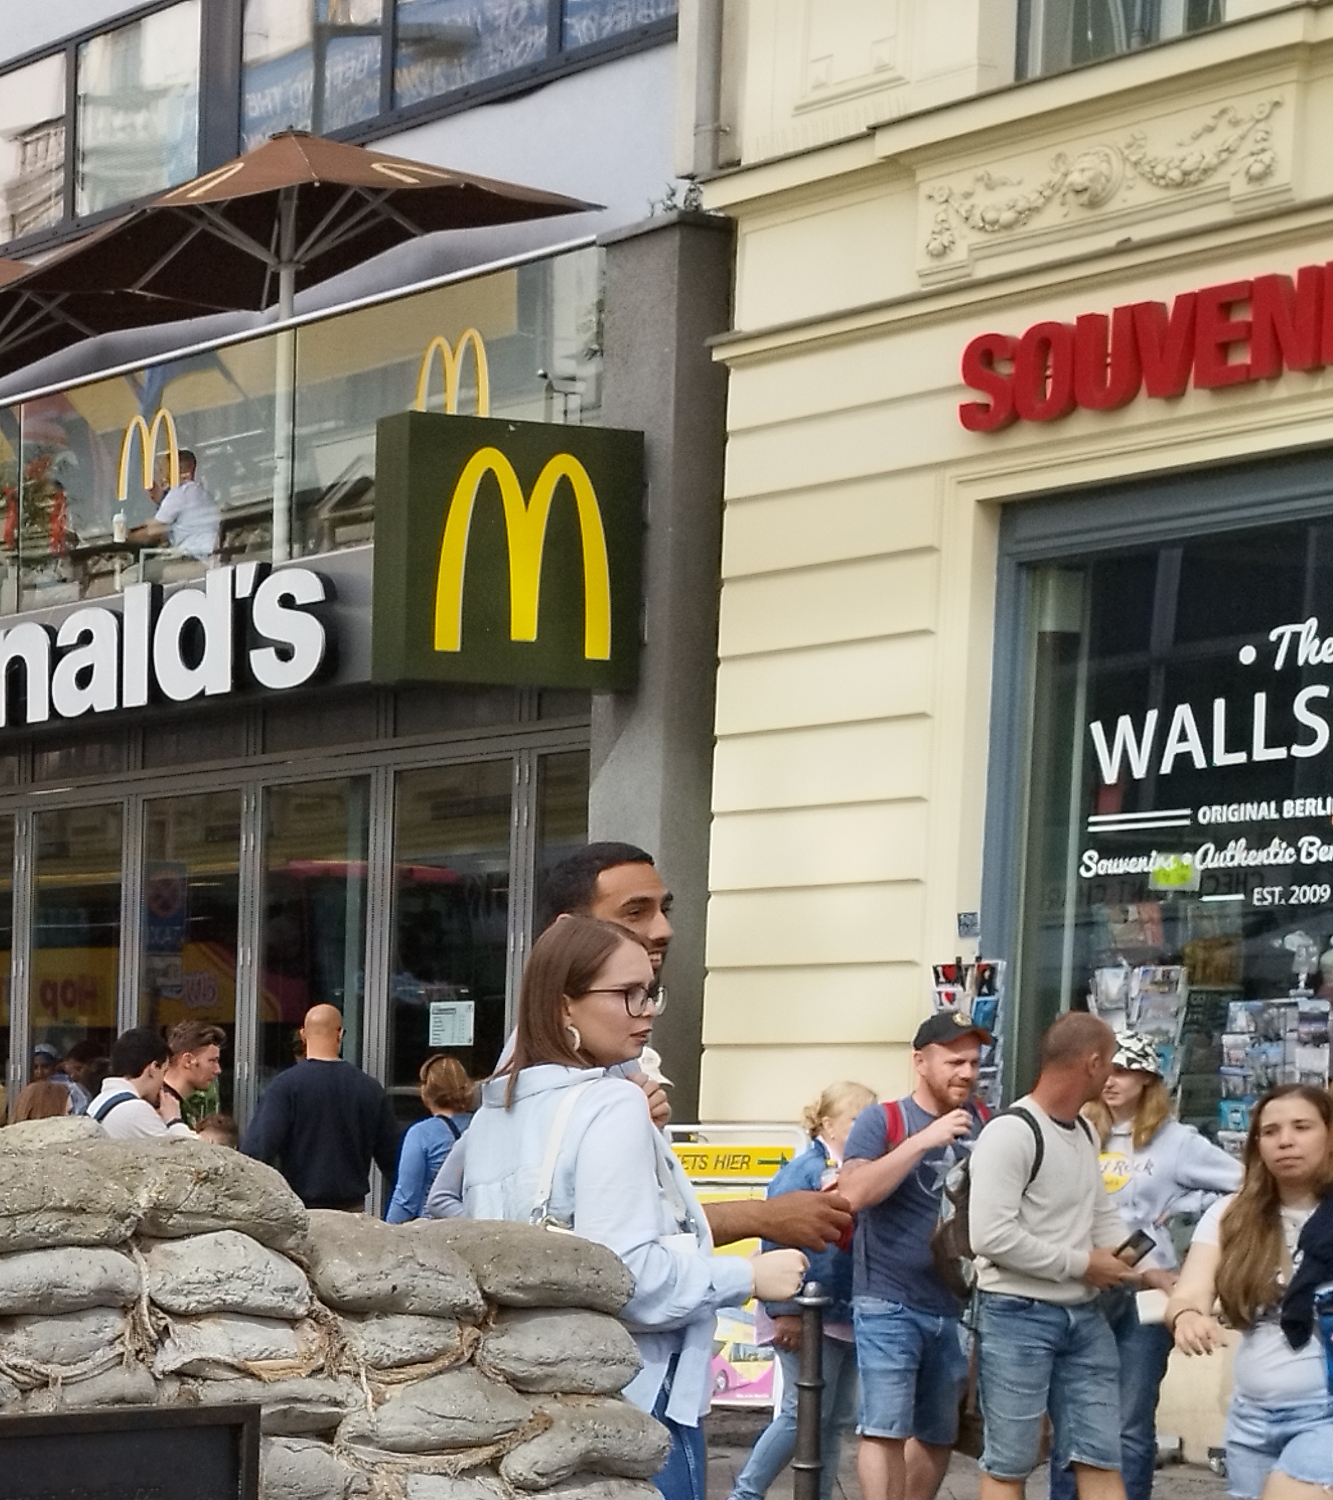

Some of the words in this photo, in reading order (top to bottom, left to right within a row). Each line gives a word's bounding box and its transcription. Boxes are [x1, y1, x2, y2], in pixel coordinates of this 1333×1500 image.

[1268, 616, 1333, 671] The
[1089, 684, 1331, 785] WALLS
[1197, 801, 1280, 825] ORIGINAL
[1079, 850, 1175, 878] Souvenirs
[1195, 836, 1297, 871] Authentic
[1252, 886, 1286, 906] EST.
[1288, 883, 1331, 905] 2009
[678, 1154, 710, 1170] ETS
[713, 1154, 751, 1171] HIER
